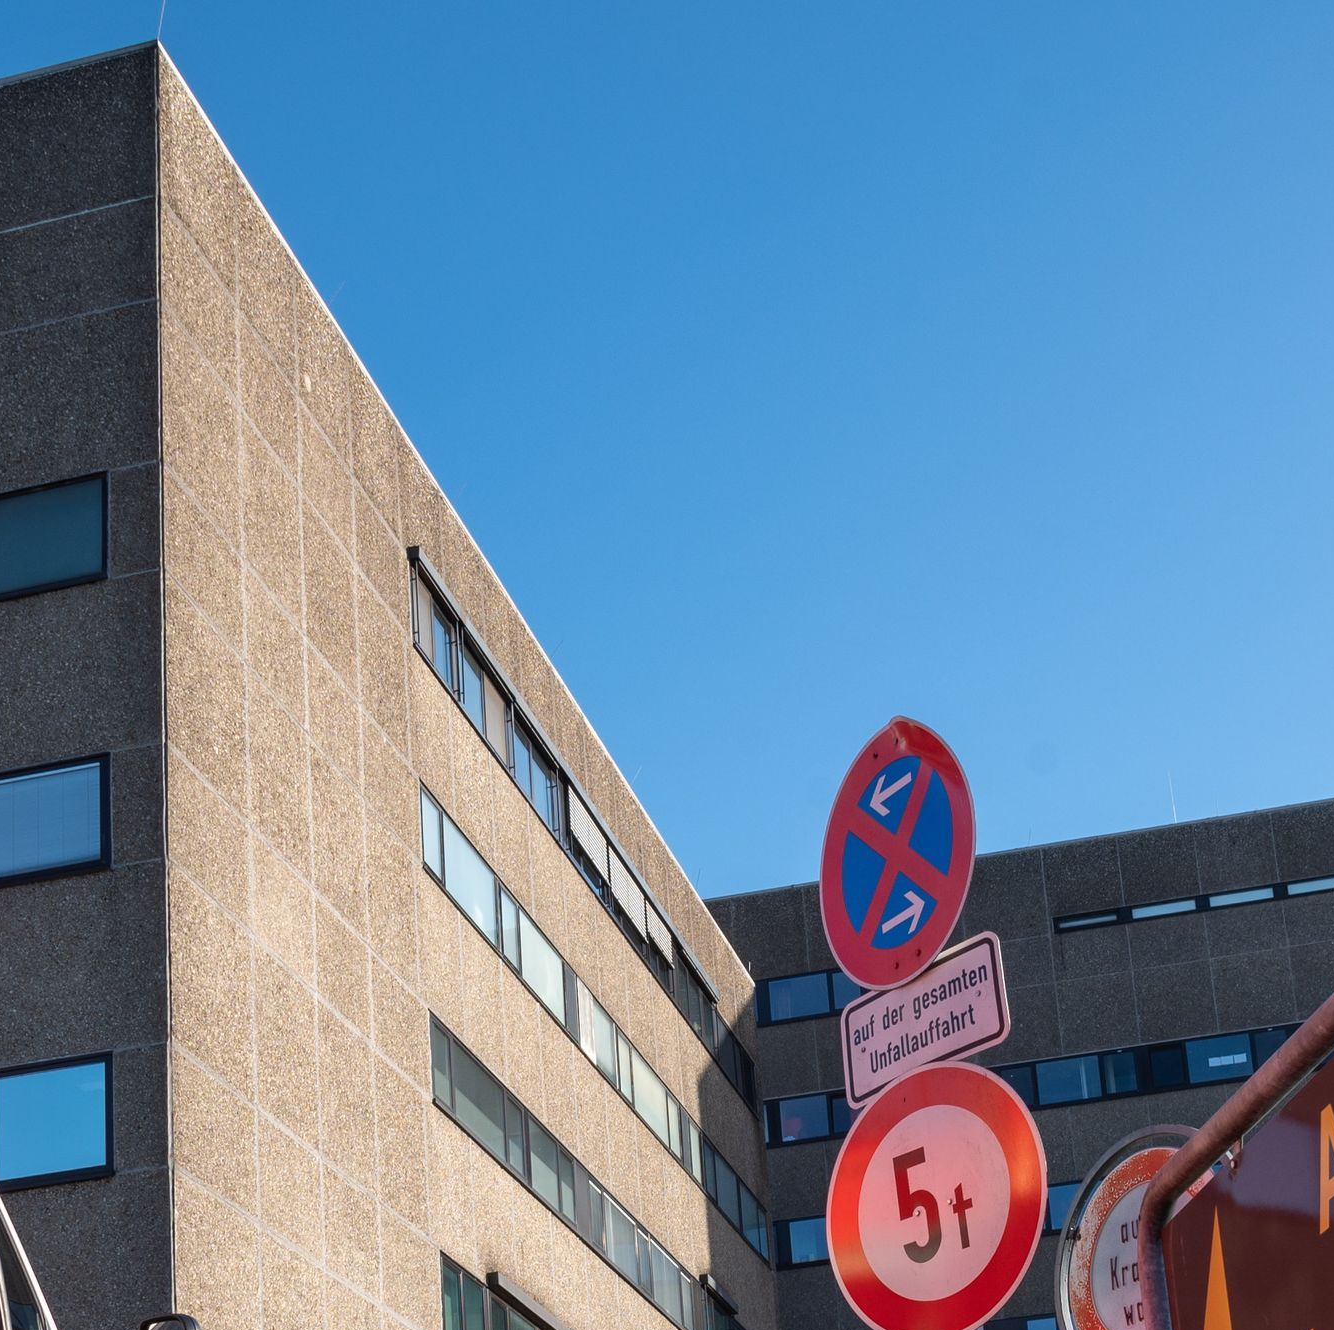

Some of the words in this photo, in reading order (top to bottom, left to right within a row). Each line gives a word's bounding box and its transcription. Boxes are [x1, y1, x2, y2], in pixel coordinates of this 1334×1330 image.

[853, 1014, 875, 1047] auf
[882, 1002, 905, 1031] der
[913, 964, 988, 1021] gesamten
[869, 1004, 976, 1074] Unfallauffahrt
[892, 1146, 942, 1263] 5
[952, 1182, 973, 1249] t
